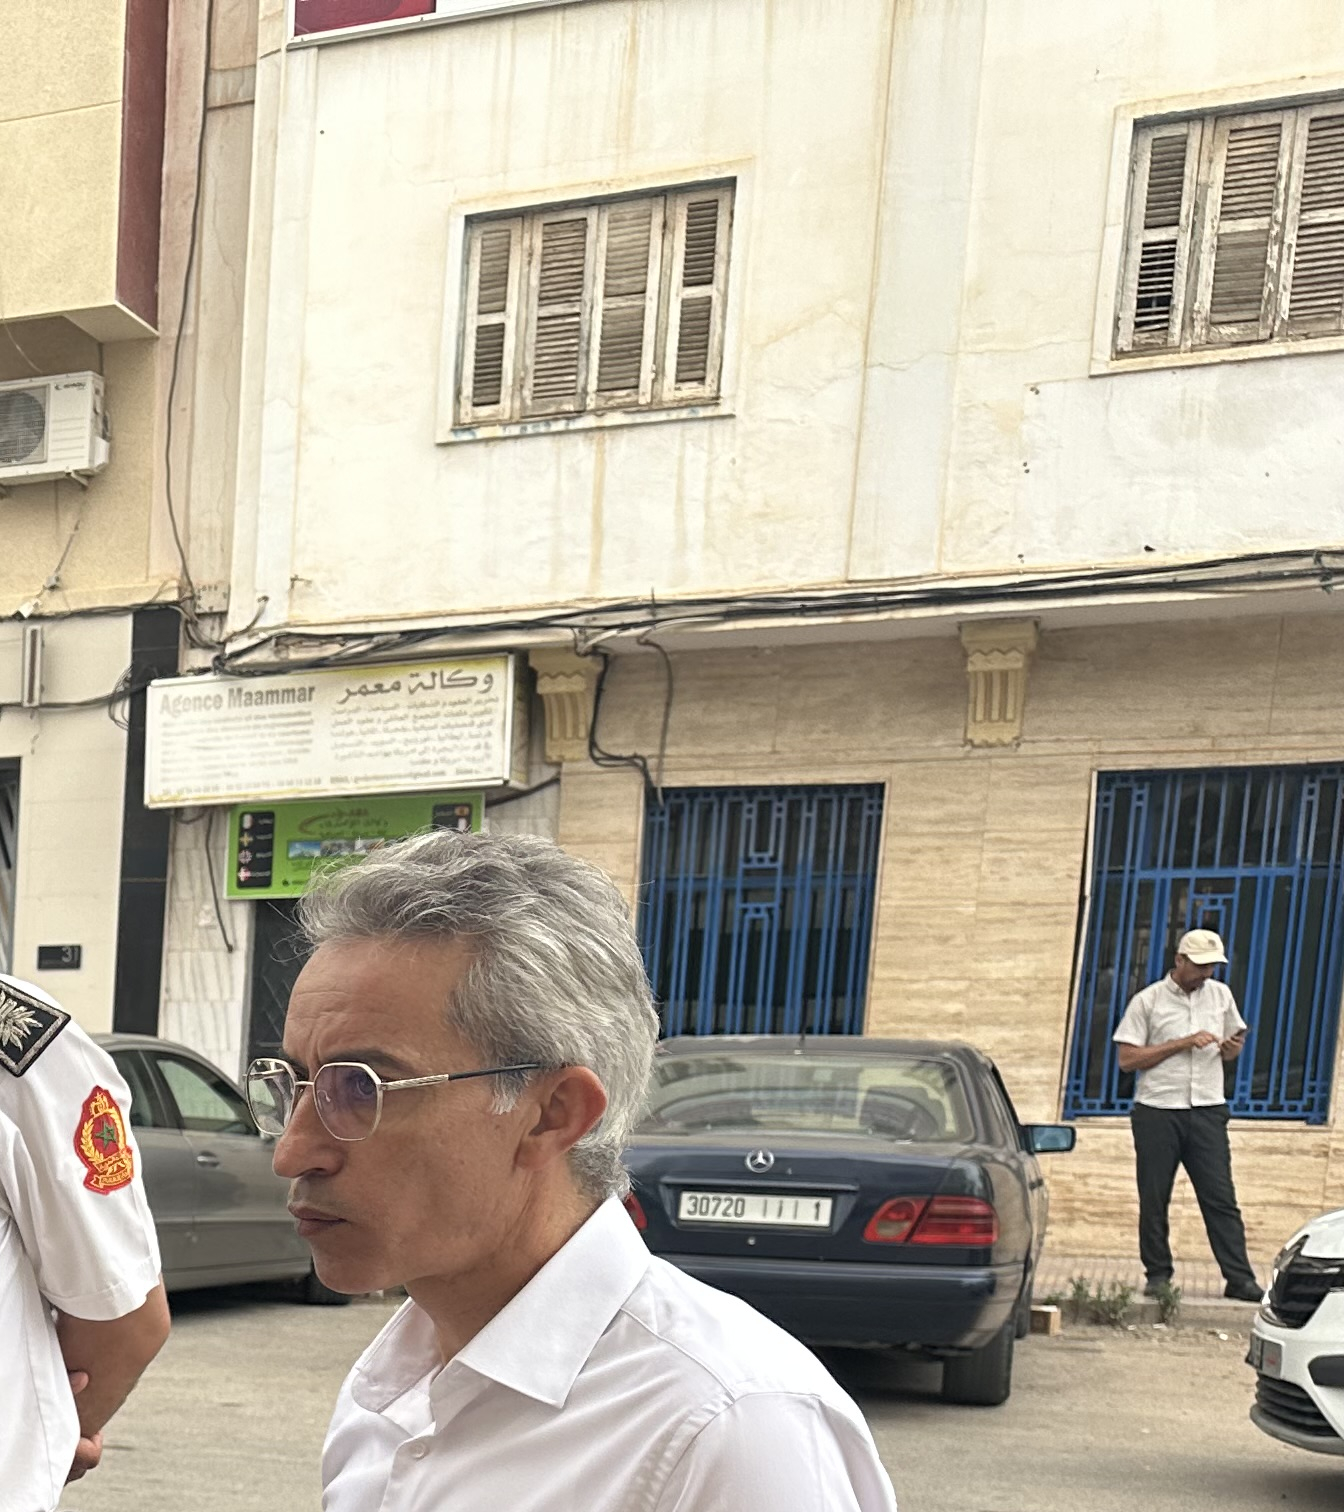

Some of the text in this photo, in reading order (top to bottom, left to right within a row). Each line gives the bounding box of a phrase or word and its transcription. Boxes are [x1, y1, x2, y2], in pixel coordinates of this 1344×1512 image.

[160, 692, 224, 719] Agence
[227, 686, 316, 710] Maammar
[336, 668, 495, 705] وكالة معمر
[686, 1194, 746, 1219] 30720
